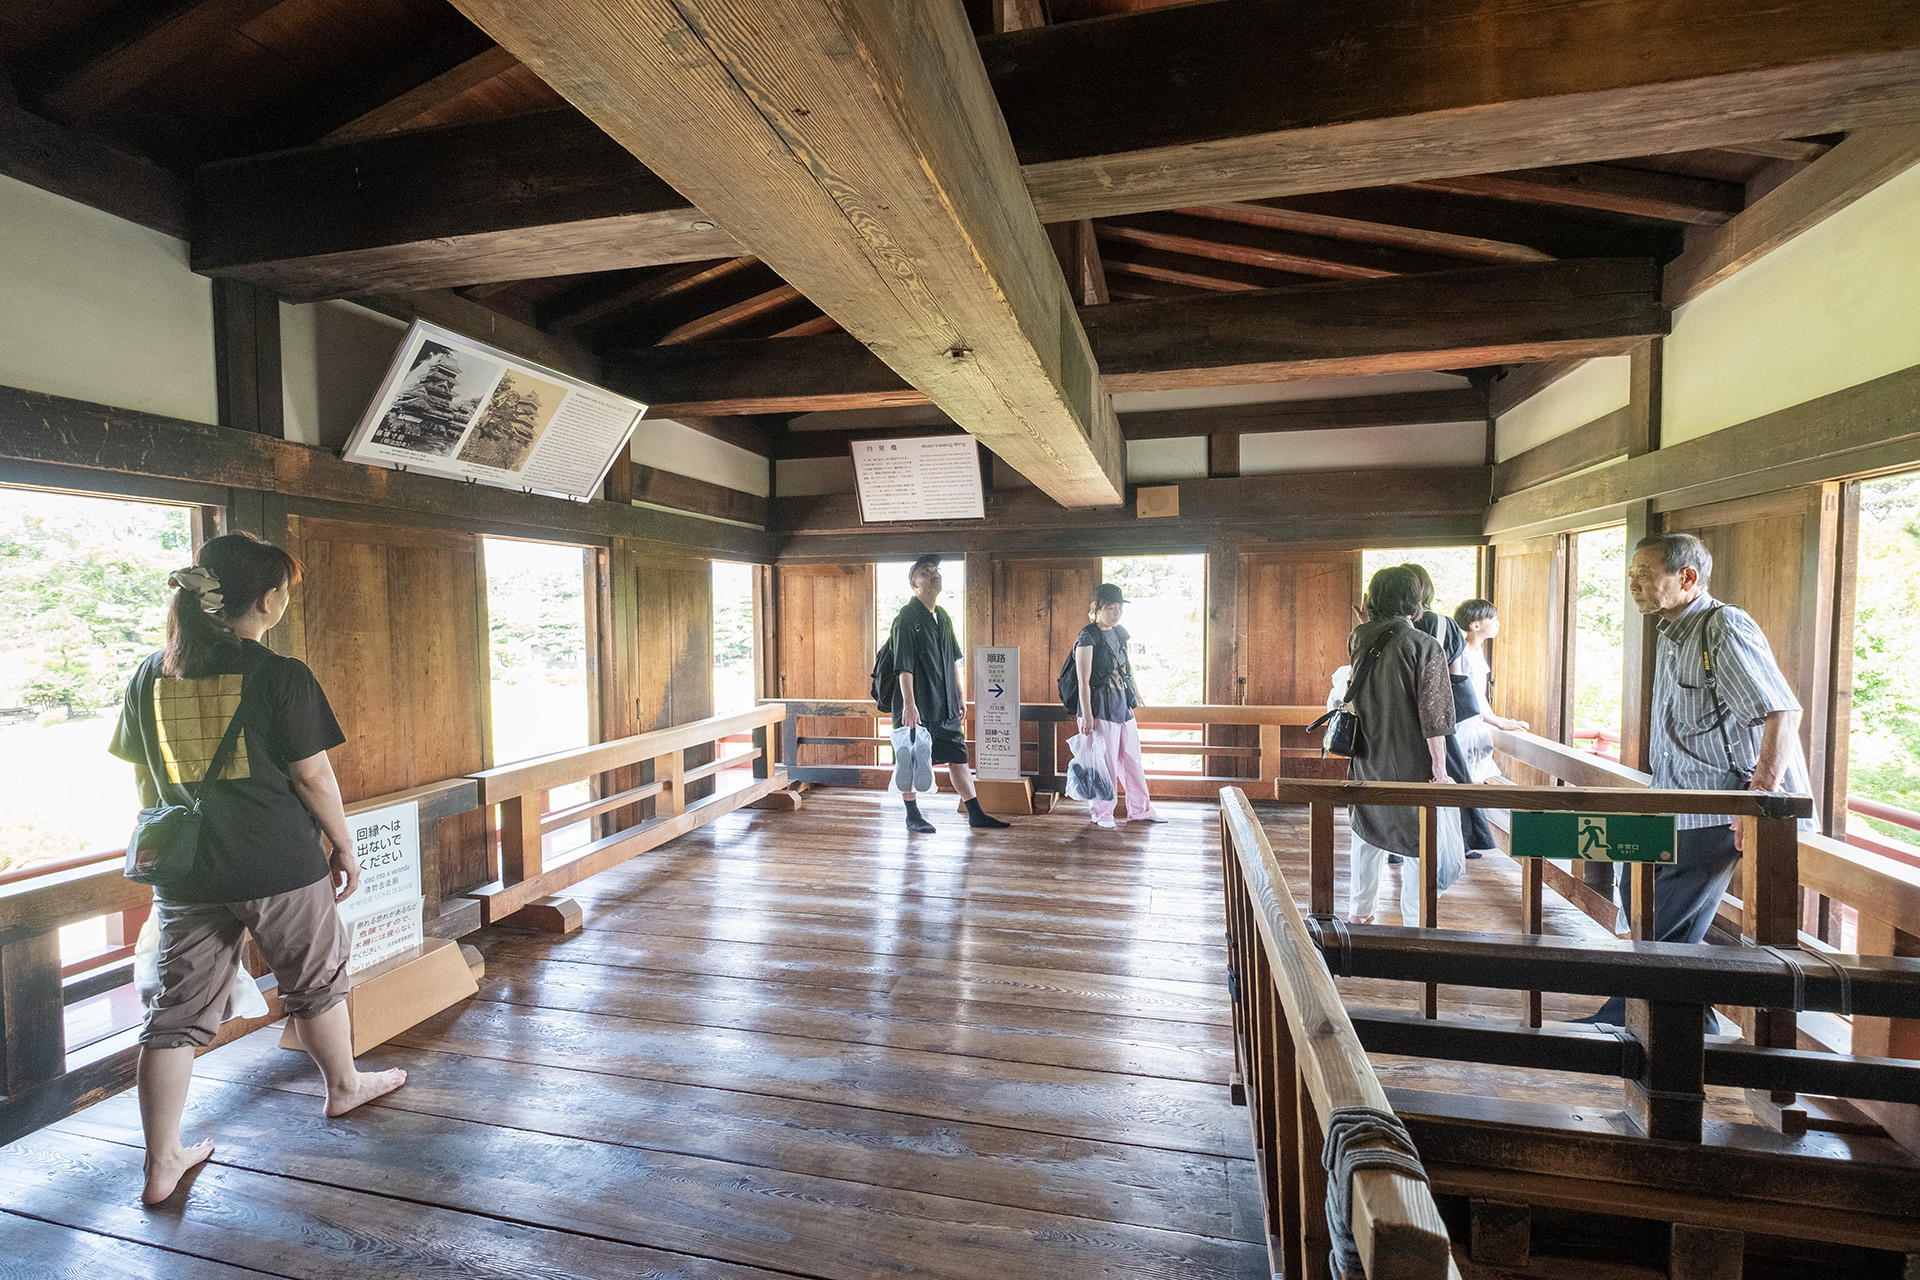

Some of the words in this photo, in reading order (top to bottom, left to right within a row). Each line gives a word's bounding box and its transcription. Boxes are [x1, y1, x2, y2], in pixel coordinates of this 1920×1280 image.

[986, 653, 1006, 663] 順路
[356, 819, 401, 841] 回縁へは
[358, 834, 402, 857] 出ないで
[360, 850, 402, 870] ください
[364, 876, 375, 884] step
[376, 872, 386, 880] into
[391, 864, 410, 874] veranda
